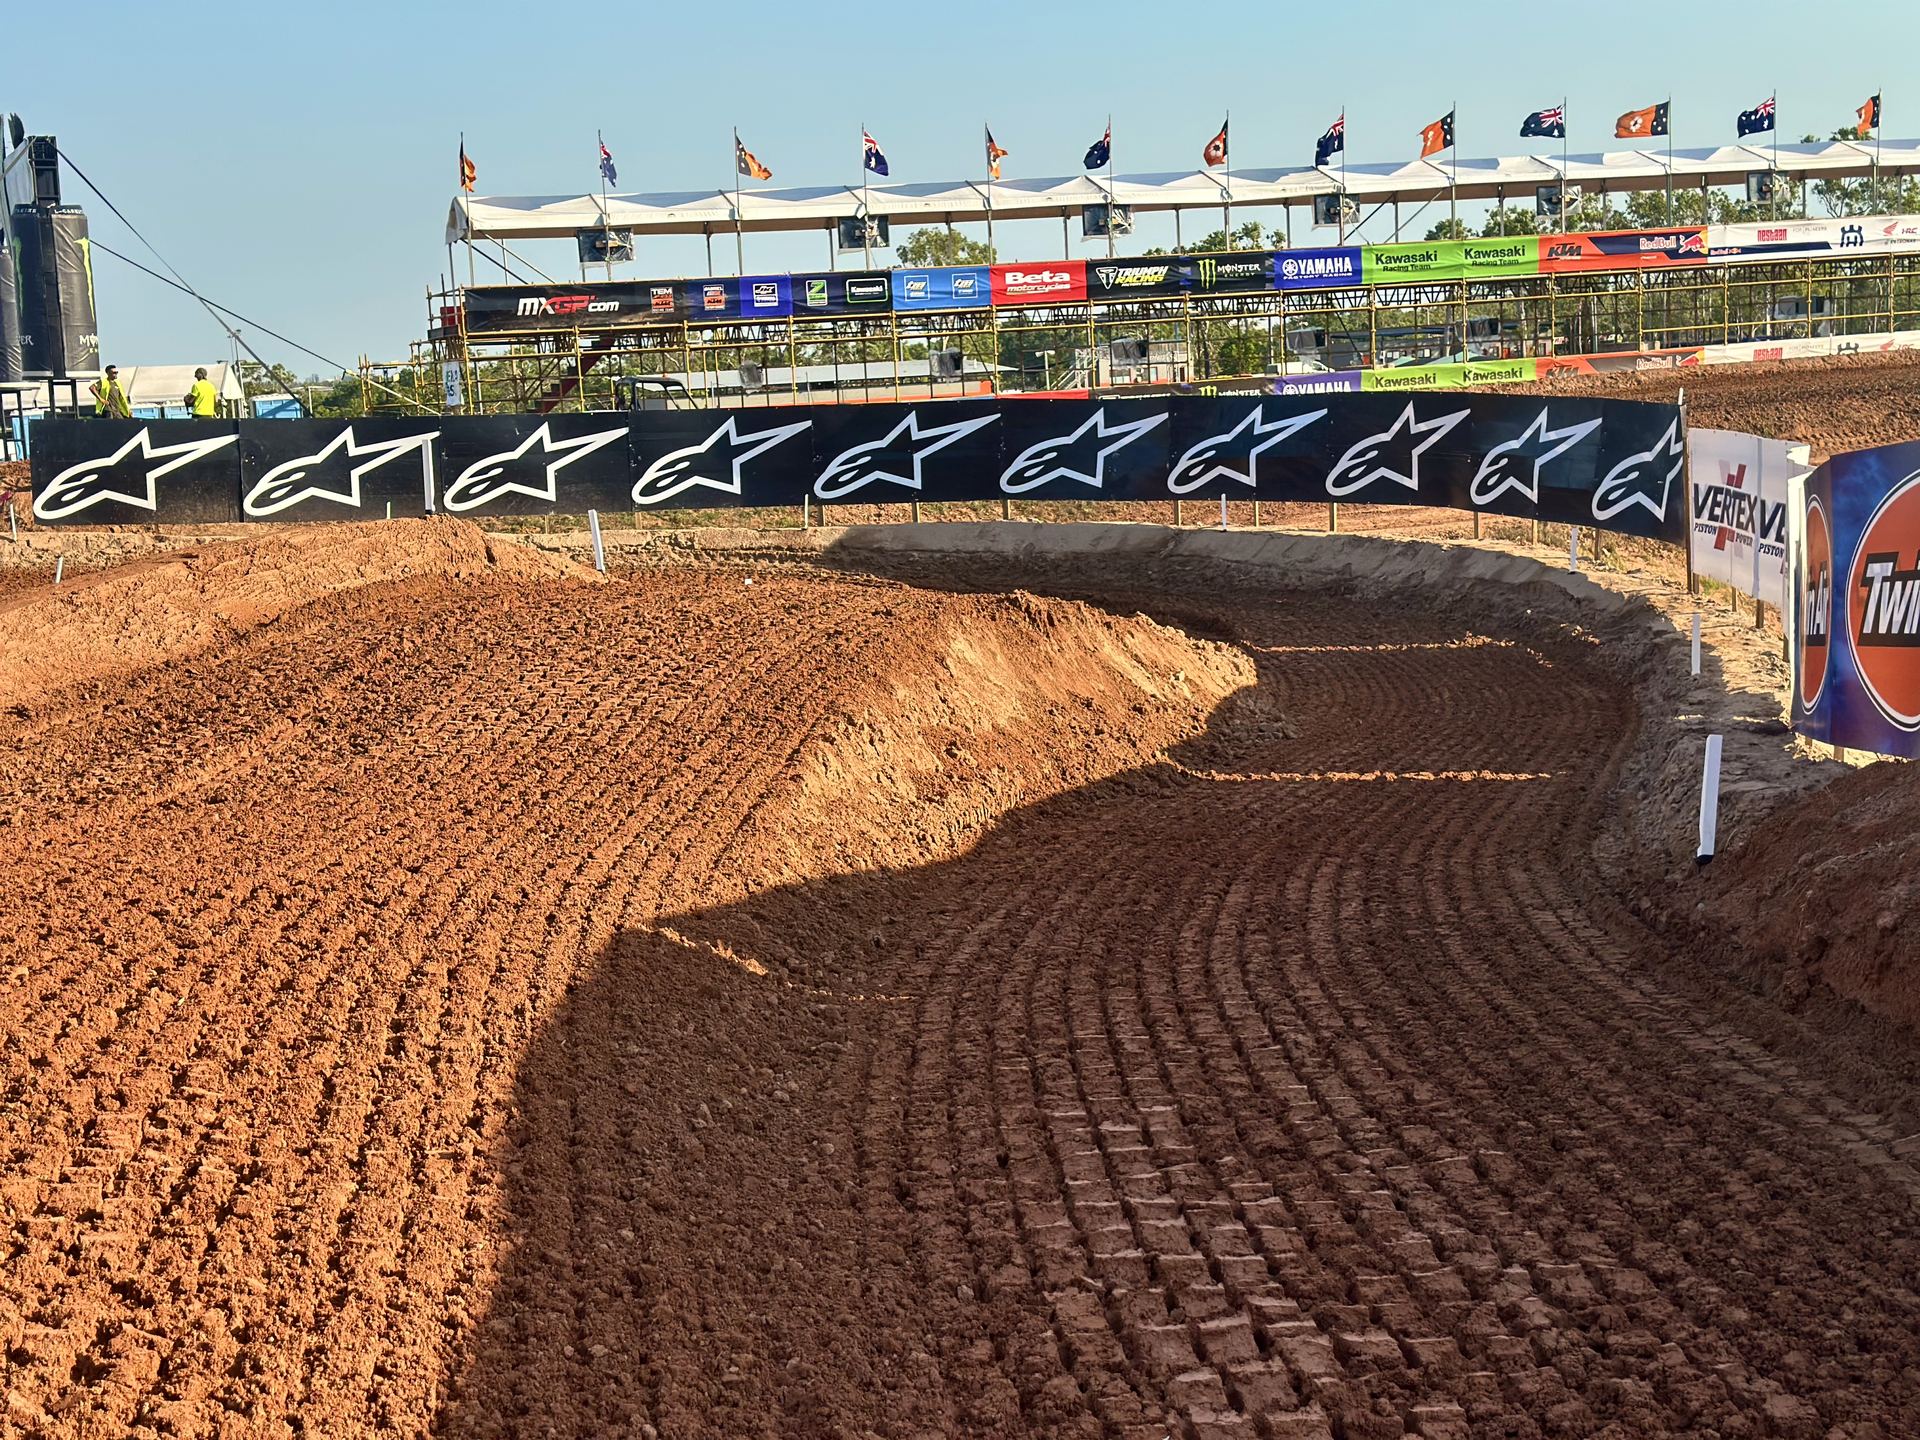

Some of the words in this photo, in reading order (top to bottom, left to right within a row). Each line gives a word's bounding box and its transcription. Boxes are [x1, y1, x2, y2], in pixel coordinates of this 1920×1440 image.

[1375, 250, 1438, 265] Kawasaki
[1464, 245, 1526, 260] Kawasaki
[1547, 242, 1583, 258] KTM
[1217, 263, 1261, 274] MONSTER
[1297, 256, 1353, 275] YAMAHA
[1471, 259, 1498, 267] Racing
[1498, 258, 1520, 266] Team
[1005, 270, 1071, 285] Beta
[1117, 265, 1169, 278] TRIUMPH
[1114, 275, 1165, 285] RACING
[1006, 282, 1071, 294] motorcycles
[1375, 373, 1437, 389] Kawasaki
[1463, 367, 1523, 383] Kawasaki
[1297, 381, 1352, 395] YAMAHA
[1693, 483, 1758, 535] VERTEX
[1694, 522, 1718, 536] PISTON
[1735, 532, 1753, 547] POWER
[1758, 542, 1785, 558] PISTON
